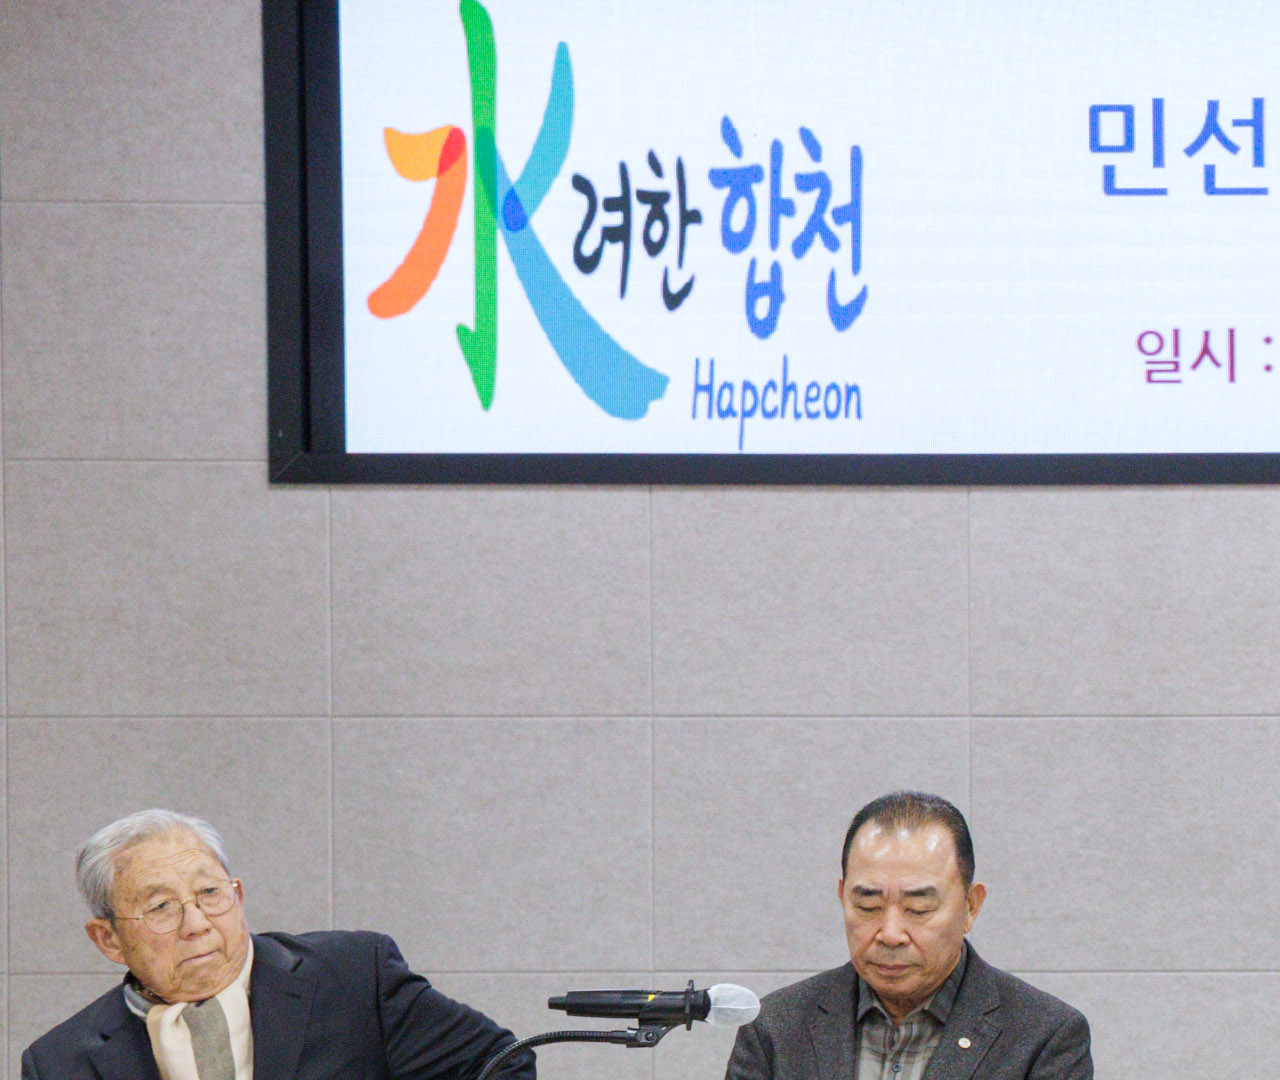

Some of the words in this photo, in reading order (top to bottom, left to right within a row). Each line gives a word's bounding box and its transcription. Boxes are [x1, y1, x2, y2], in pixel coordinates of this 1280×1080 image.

[707, 115, 868, 340] 합천
[691, 354, 863, 451] Hapcheon
[1136, 327, 1237, 384] 일시
